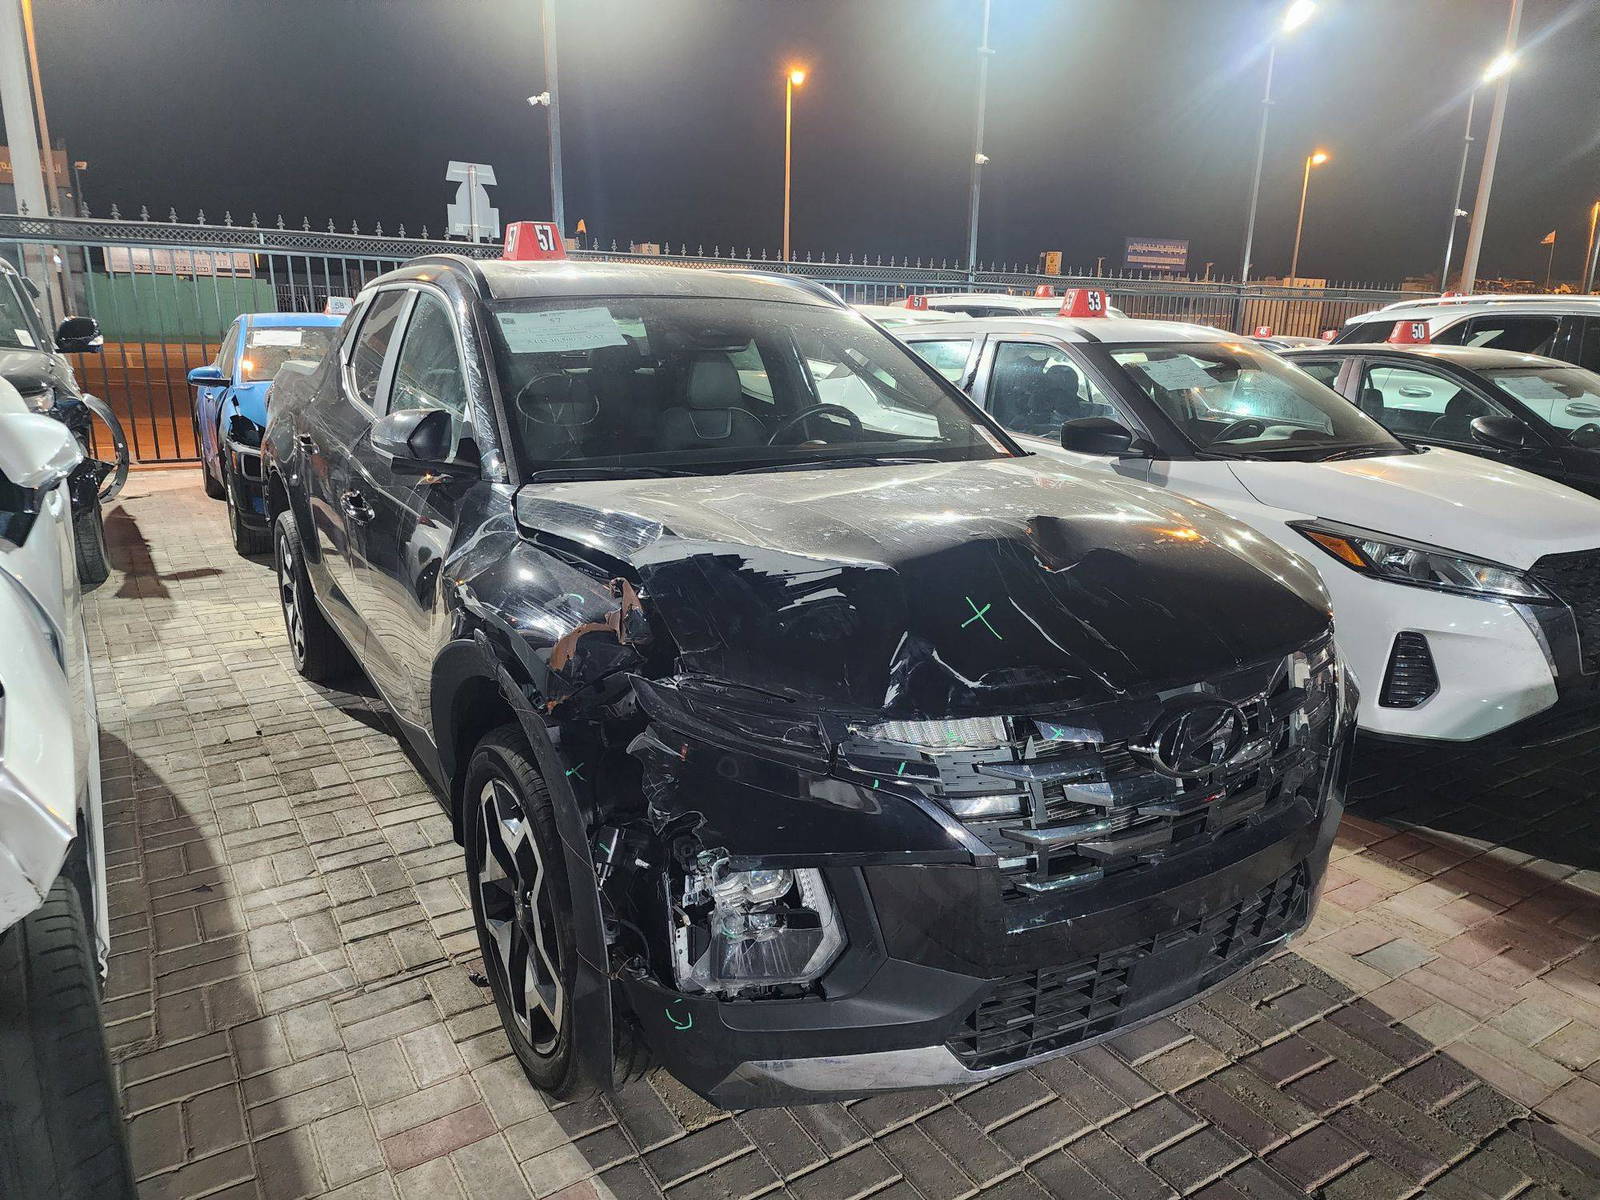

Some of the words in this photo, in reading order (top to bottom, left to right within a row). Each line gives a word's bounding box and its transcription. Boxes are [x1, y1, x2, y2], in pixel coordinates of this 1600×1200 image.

[534, 224, 556, 251] 57
[1087, 291, 1102, 311] 53
[1411, 323, 1425, 339] 50
